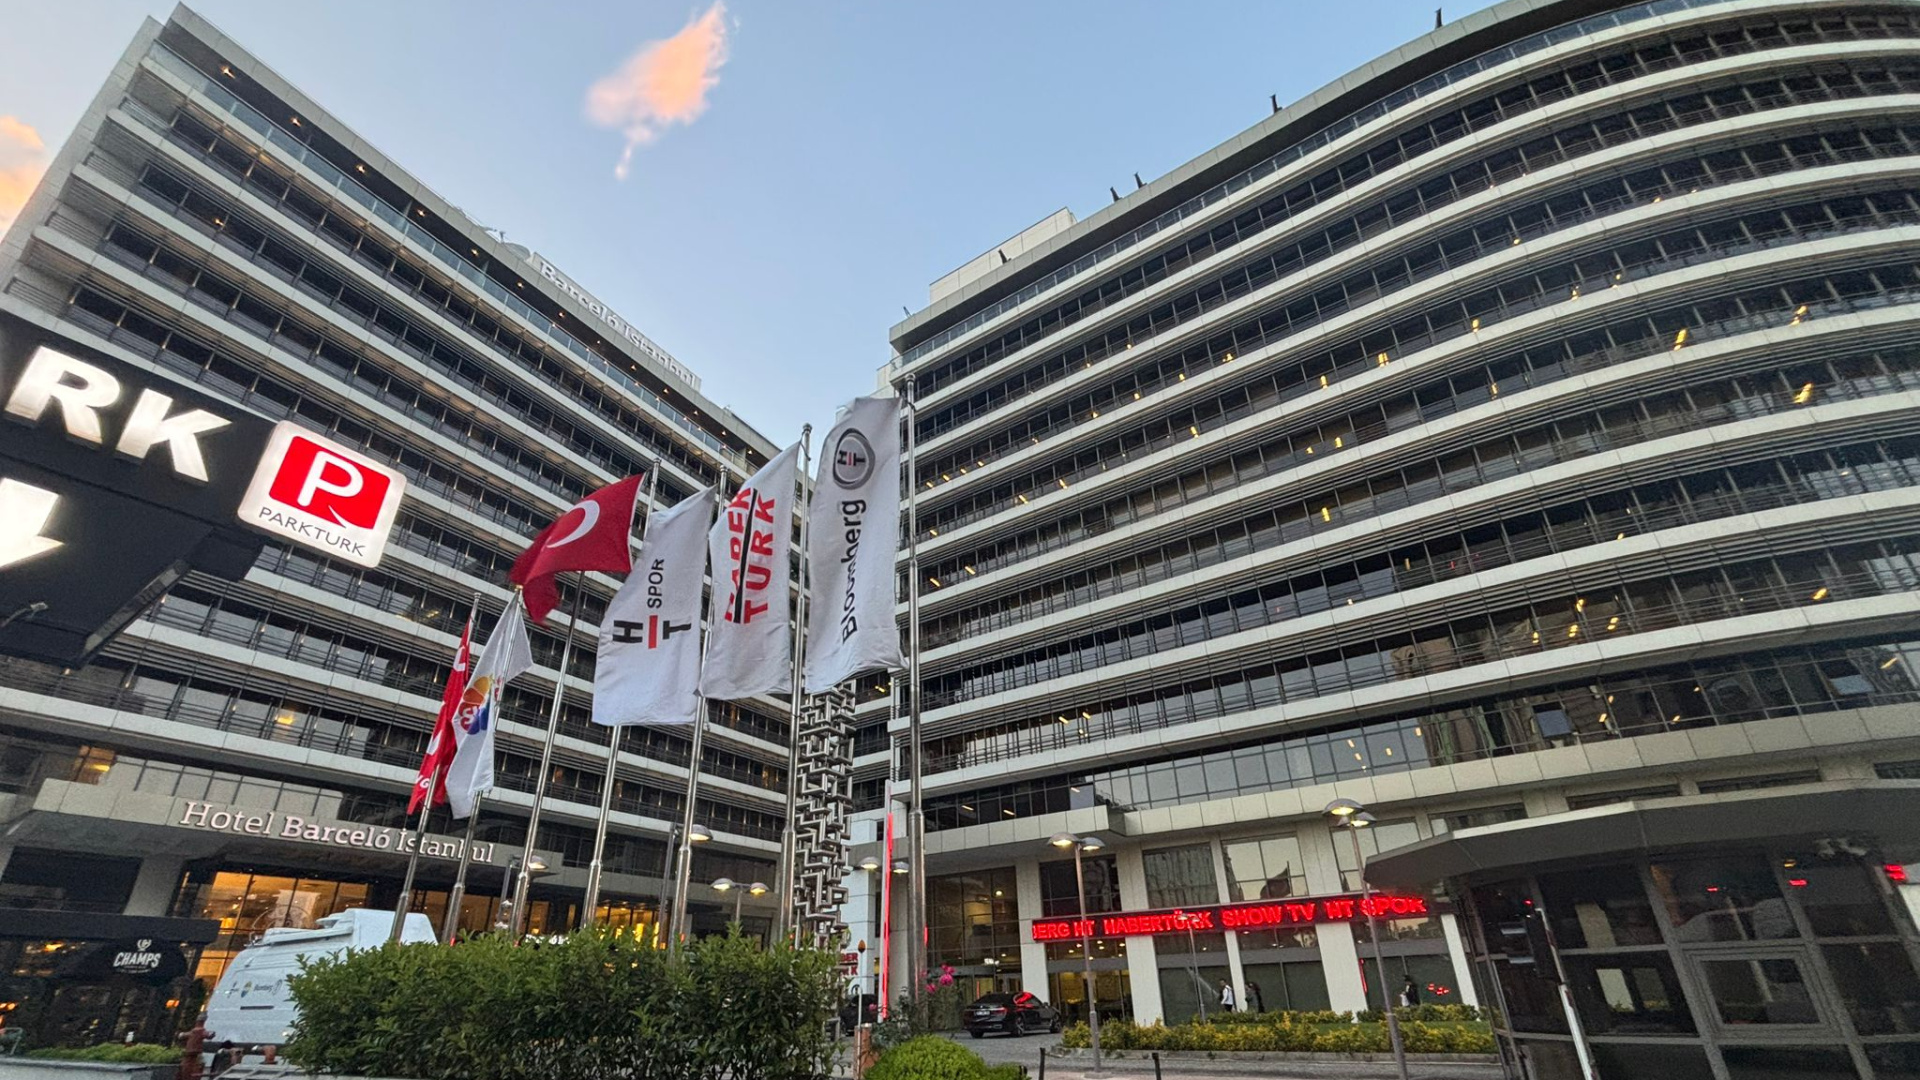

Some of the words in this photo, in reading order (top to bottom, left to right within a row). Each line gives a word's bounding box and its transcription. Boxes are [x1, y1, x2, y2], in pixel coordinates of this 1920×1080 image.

[540, 260, 620, 330] Barceló
[4, 345, 233, 482] RK
[259, 507, 366, 557] PARKTURK
[646, 558, 665, 609] SPOR
[179, 801, 274, 836] Hotel
[280, 815, 392, 850] Barceló
[1073, 919, 1095, 937] HT
[1221, 904, 1283, 927] SHOW
[1286, 902, 1316, 921] TV
[1324, 900, 1355, 919] HT
[113, 952, 162, 968] CHAMPS
